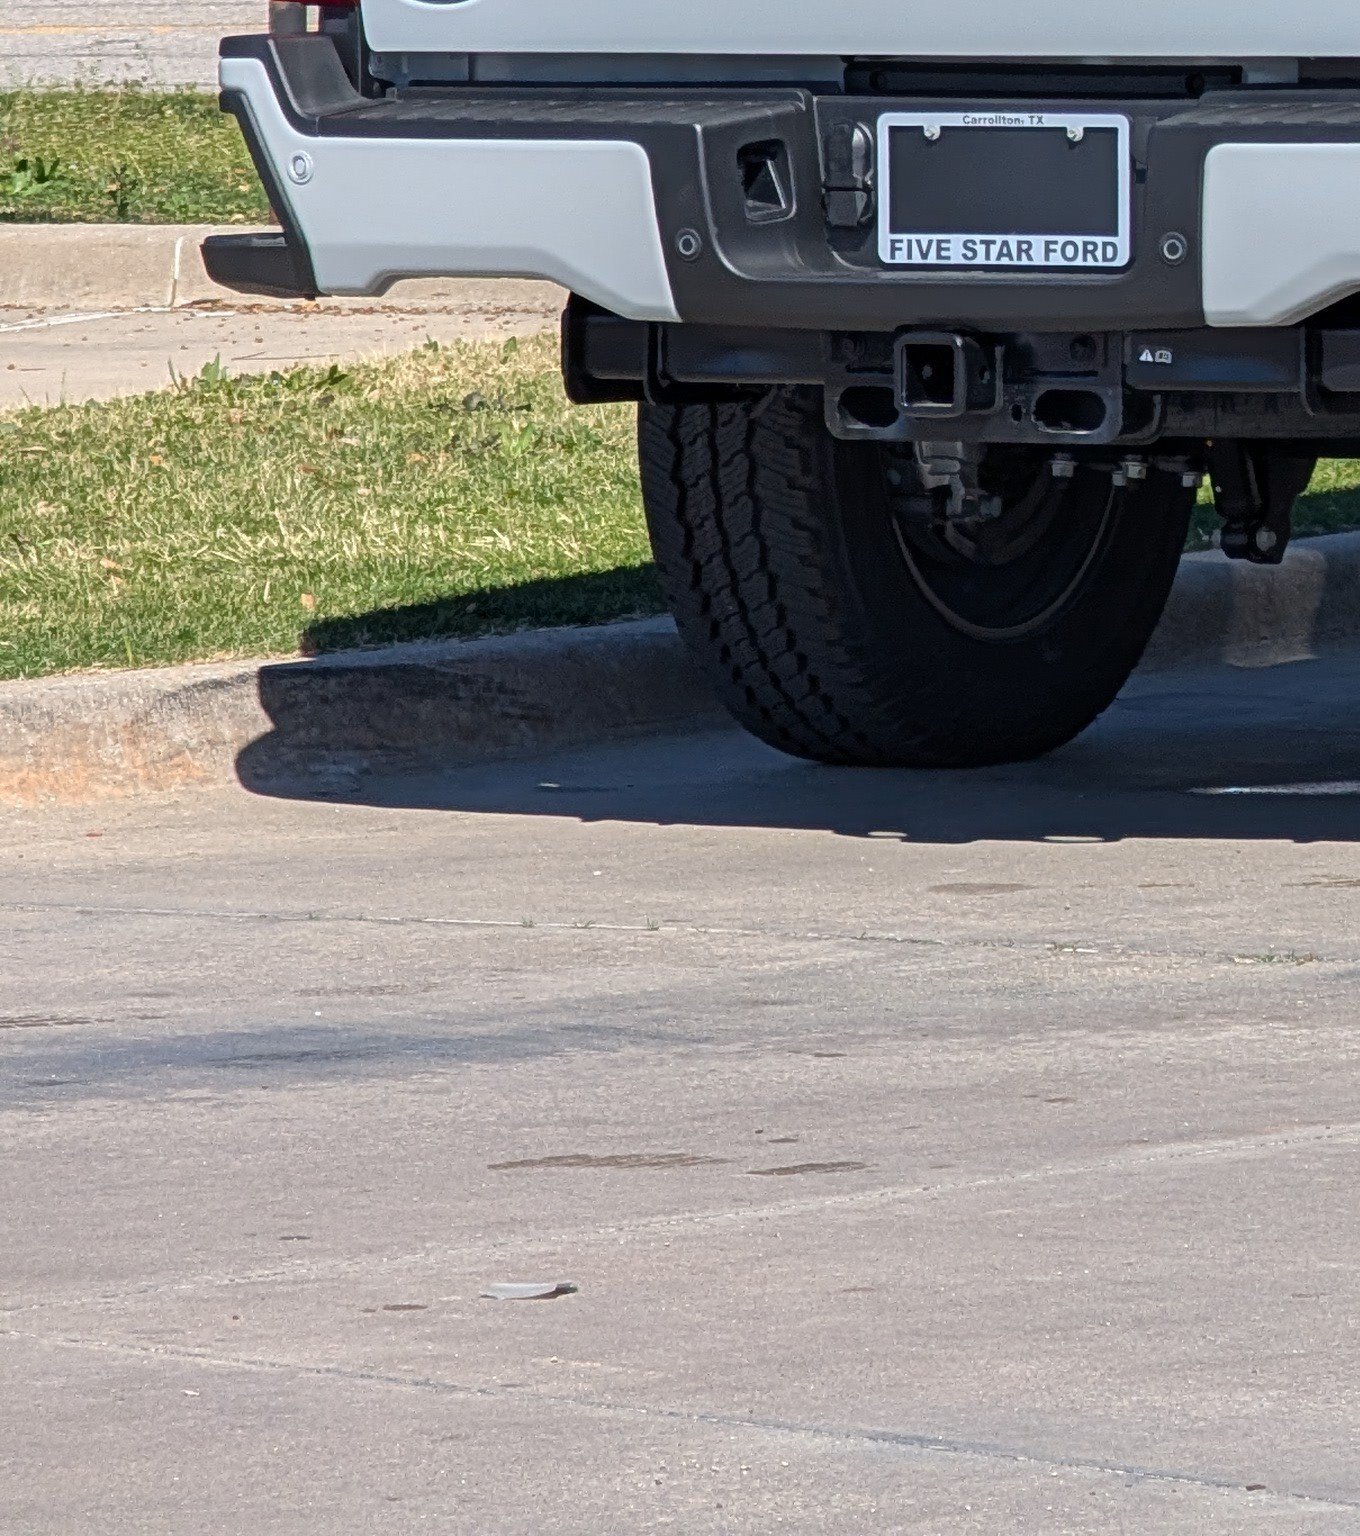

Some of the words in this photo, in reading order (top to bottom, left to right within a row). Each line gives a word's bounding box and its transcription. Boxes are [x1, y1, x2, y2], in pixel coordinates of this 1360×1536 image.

[1028, 114, 1045, 126] TX
[889, 238, 952, 261] FIVE
[961, 238, 1034, 262] STAR
[1043, 239, 1119, 263] FORD
